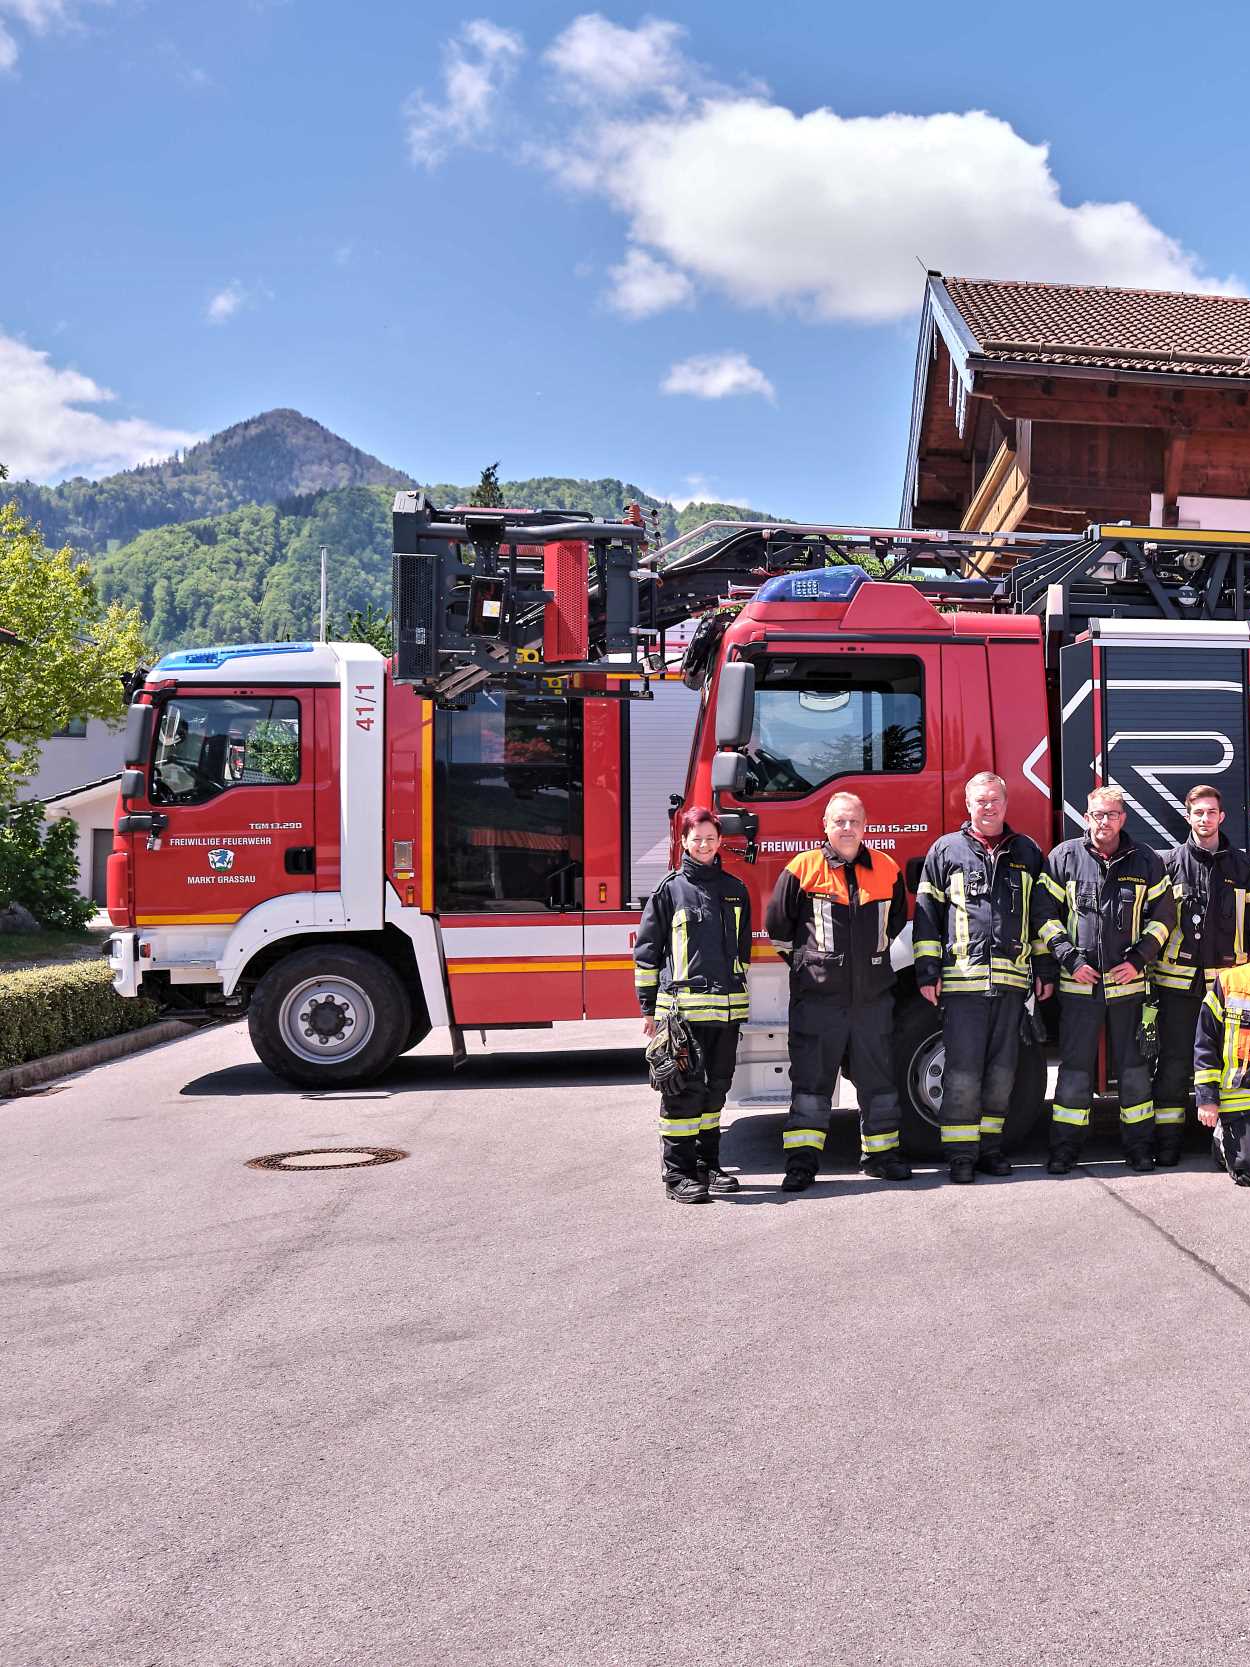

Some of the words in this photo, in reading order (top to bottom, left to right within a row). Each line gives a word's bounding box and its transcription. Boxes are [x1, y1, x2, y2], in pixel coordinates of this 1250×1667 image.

[354, 685, 377, 732] 41/1
[169, 838, 220, 846] FREIWILLIGE
[222, 837, 272, 846] FEUERWEHR
[760, 840, 825, 852] FREIWILLIG
[187, 876, 215, 885] MARKT
[217, 875, 256, 884] GRASSAU
